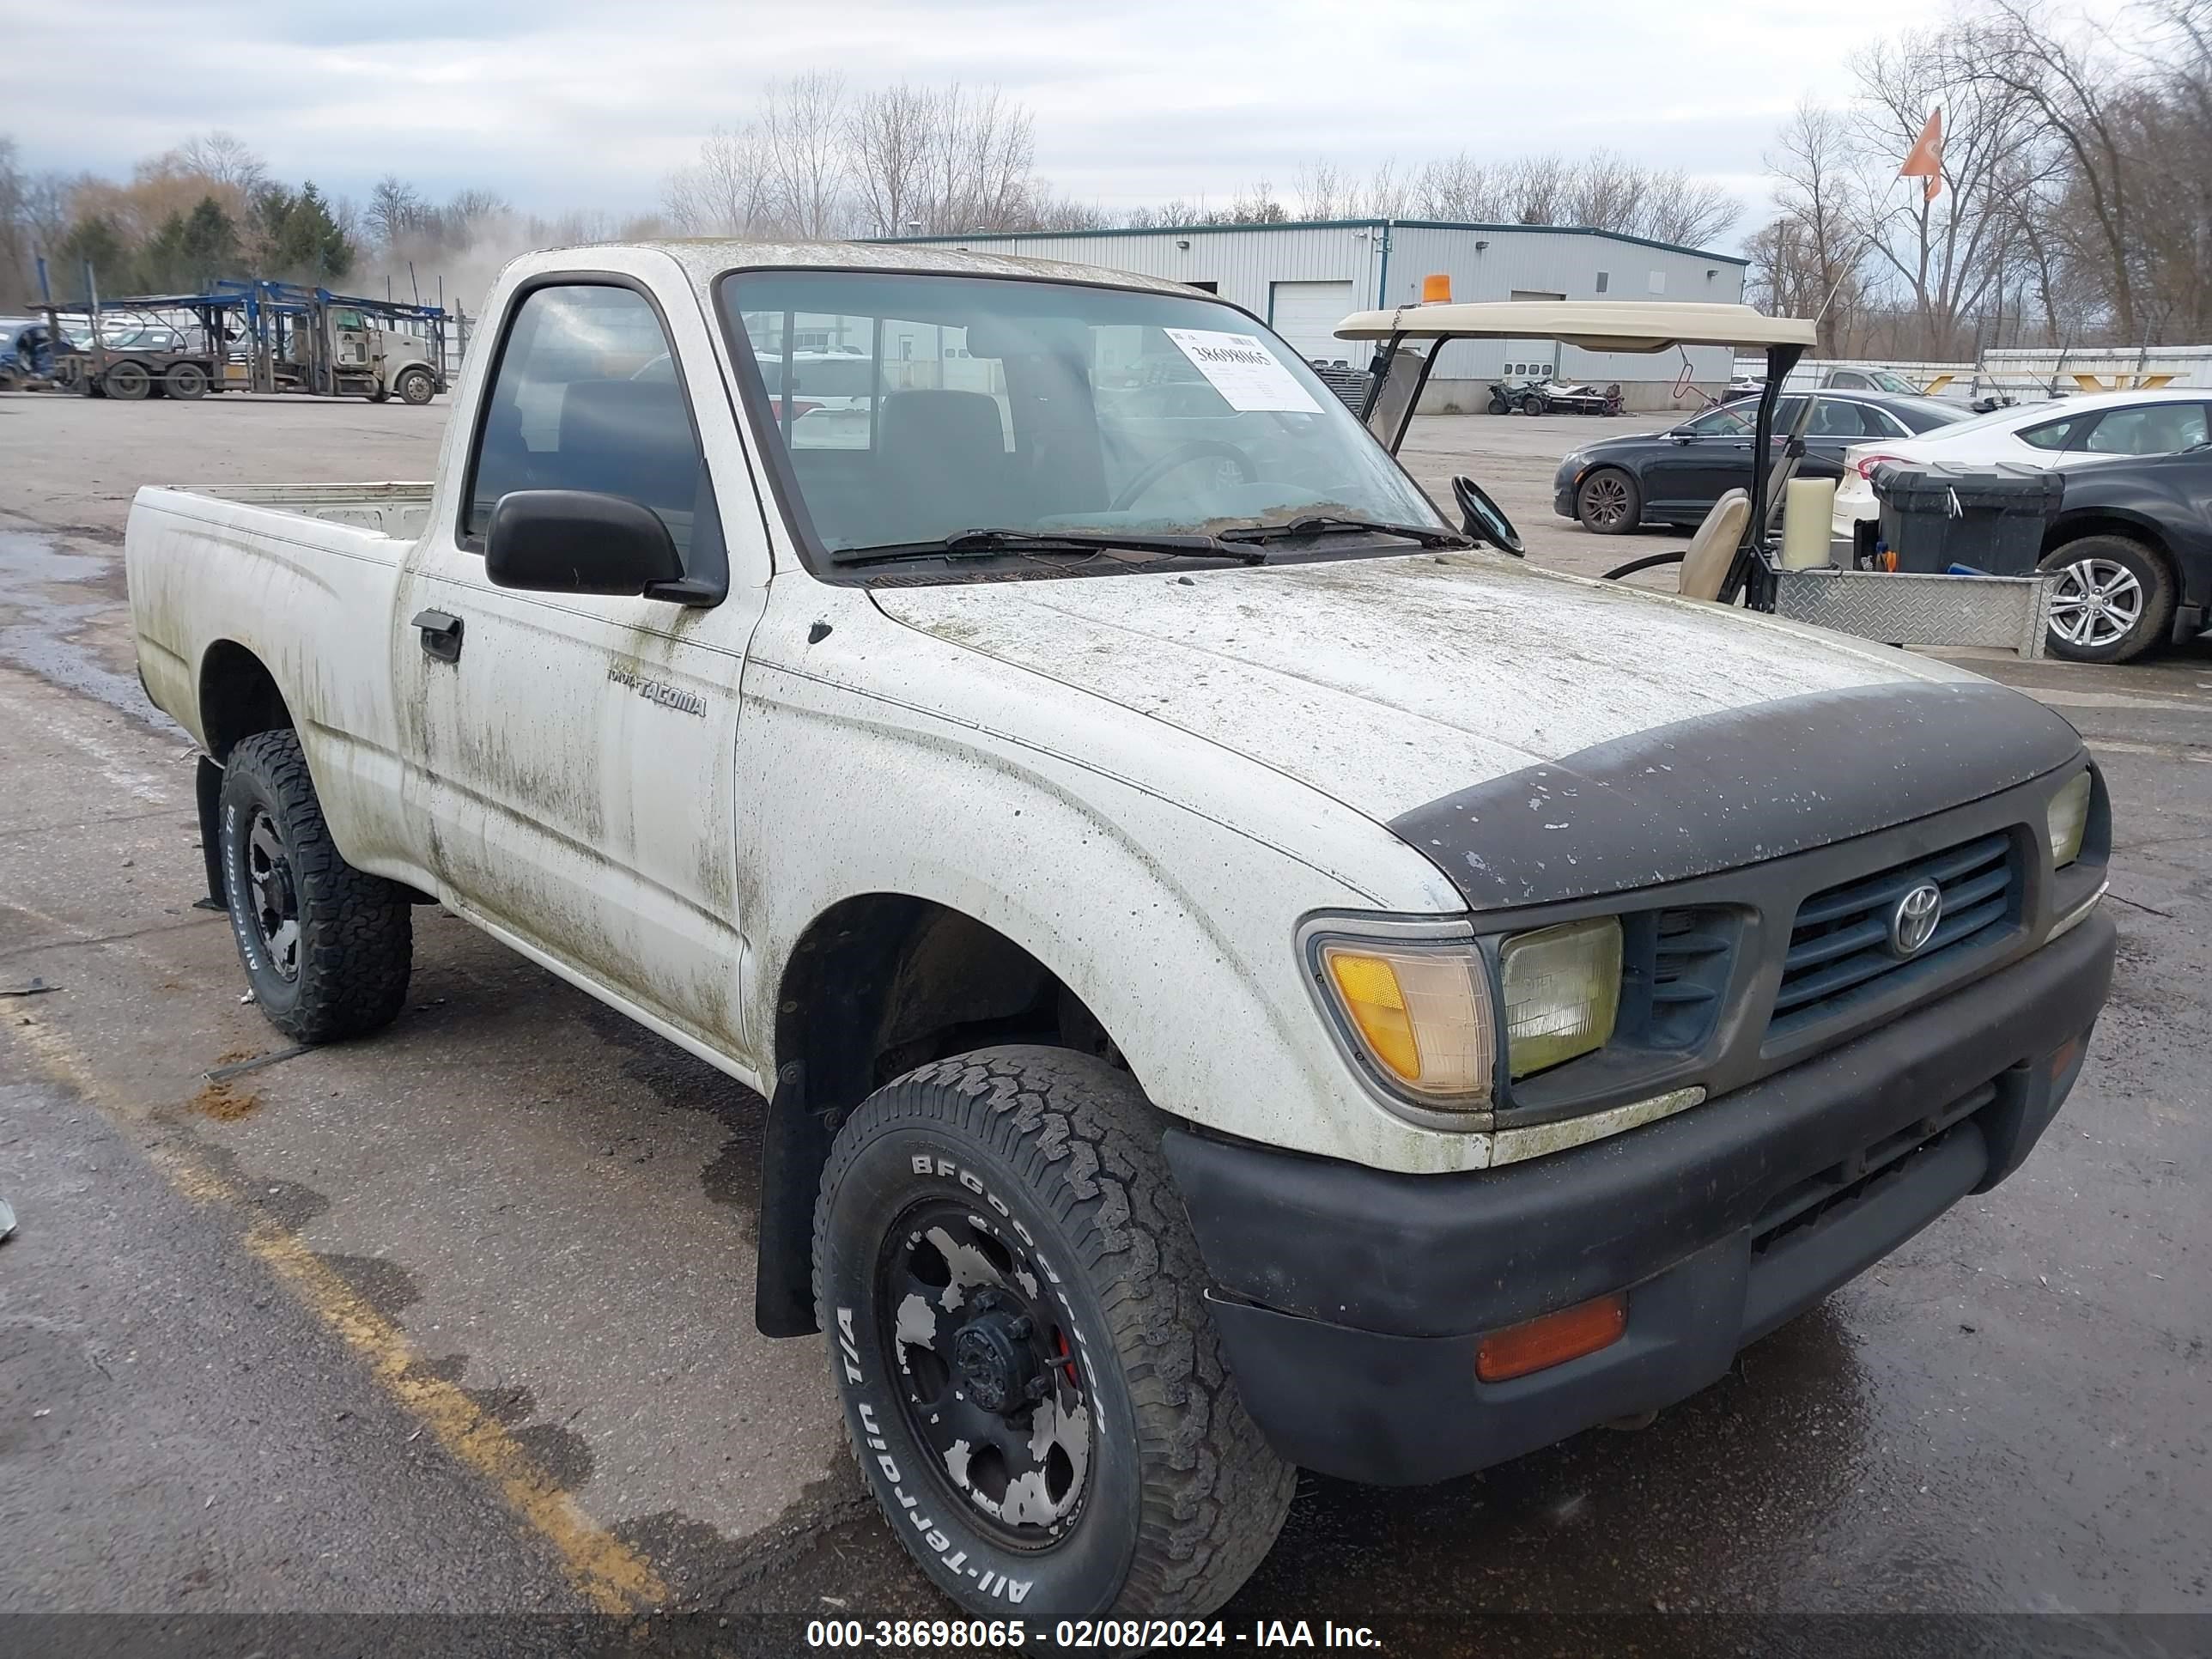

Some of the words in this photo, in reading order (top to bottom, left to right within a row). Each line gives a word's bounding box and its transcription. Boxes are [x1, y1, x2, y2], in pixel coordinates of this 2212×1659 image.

[1192, 346, 1272, 366] 38698065
[605, 667, 638, 689] TOYOTA
[637, 678, 708, 717] TACOMA
[226, 805, 235, 835] T/A
[226, 845, 258, 970] All-Terrain
[911, 1155, 1106, 1434] BFGoodrich
[837, 1307, 863, 1384] T/A
[860, 1402, 1035, 1604] All-Terrain
